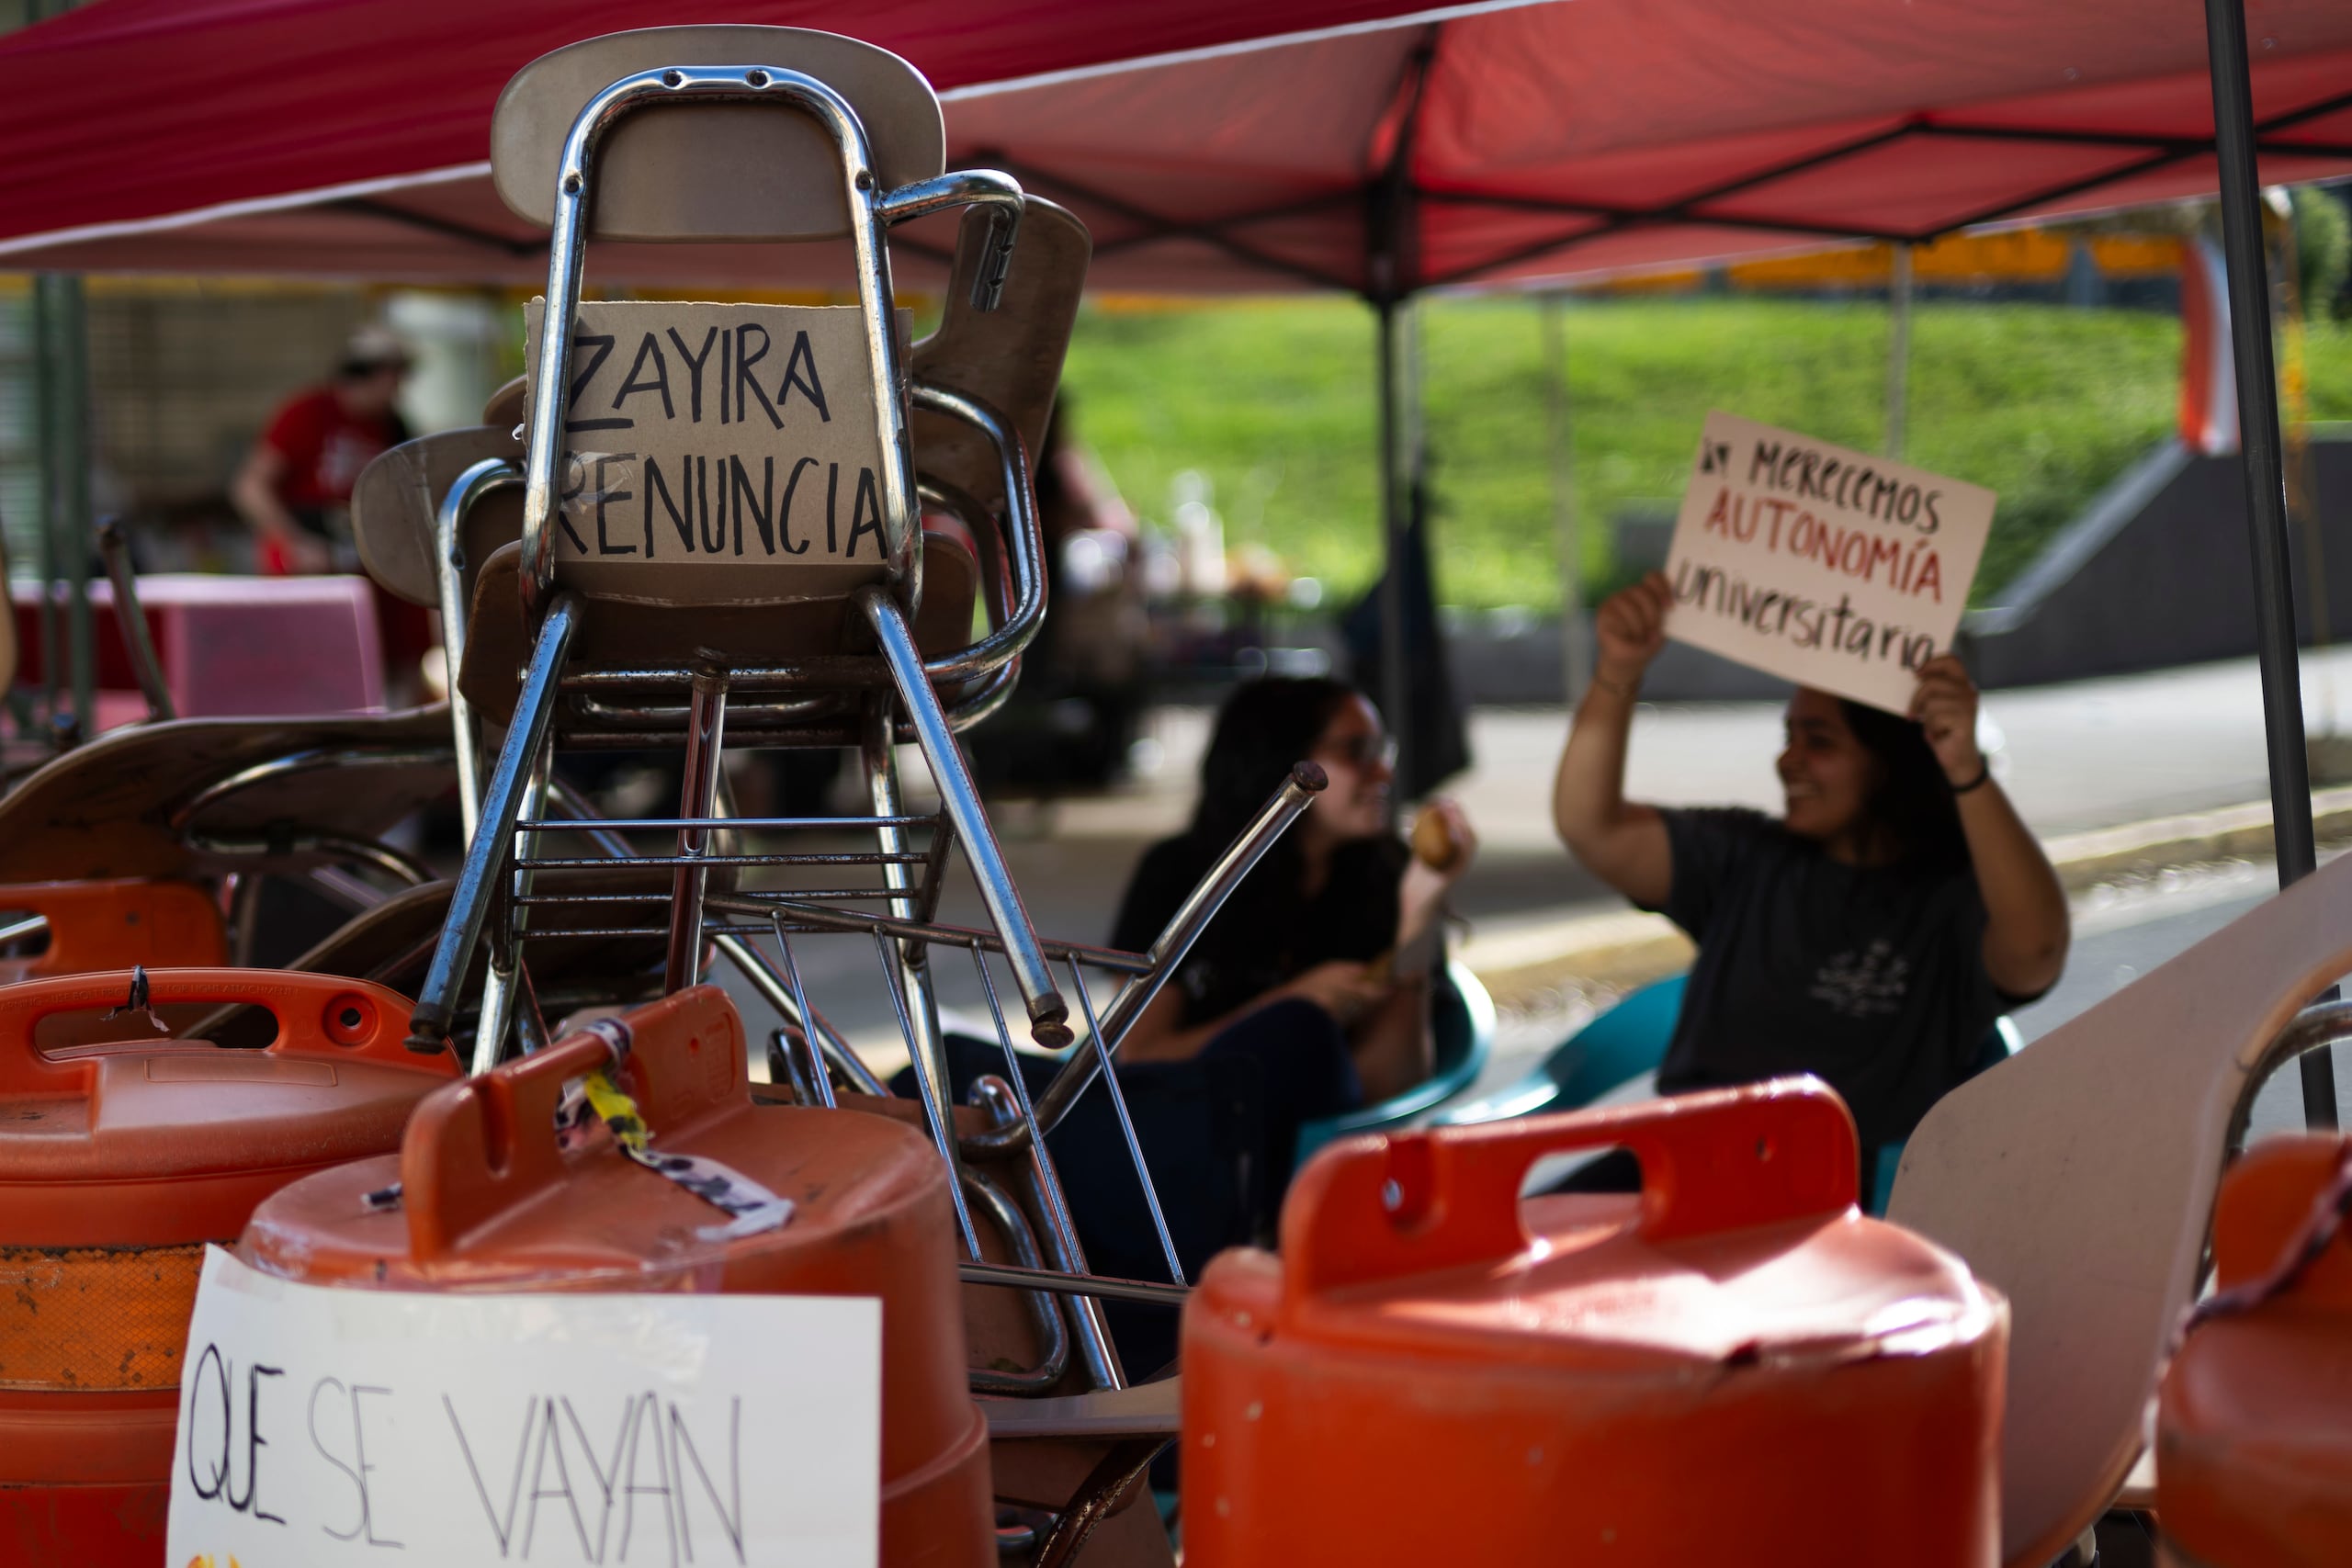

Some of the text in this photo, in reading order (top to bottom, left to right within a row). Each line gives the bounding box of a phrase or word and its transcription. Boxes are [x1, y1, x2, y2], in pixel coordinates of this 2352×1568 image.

[566, 323, 831, 430] ZAYIRA
[559, 451, 888, 559] RENUNCIA
[1703, 485, 1942, 604] AUTONOMÍA
[188, 1341, 746, 1568] QUE SE VAYAN
